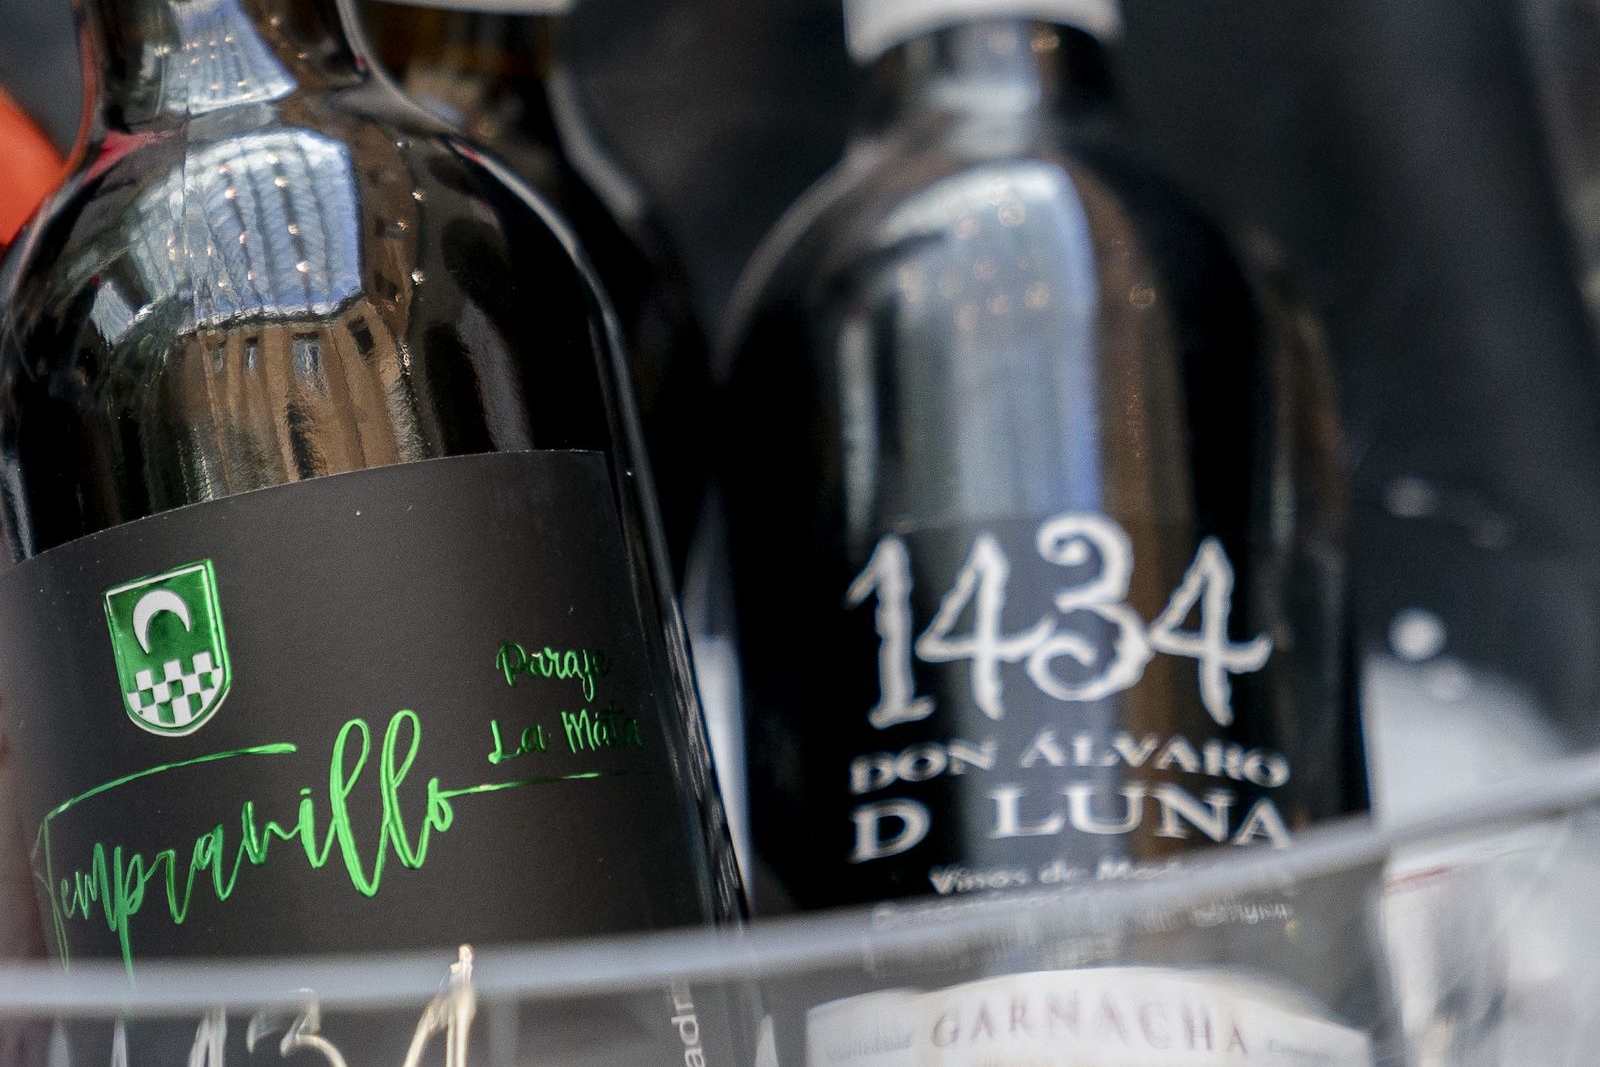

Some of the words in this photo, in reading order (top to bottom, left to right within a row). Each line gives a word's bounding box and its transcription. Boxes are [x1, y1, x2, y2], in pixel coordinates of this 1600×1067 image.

[845, 511, 1276, 730] 1434
[487, 719, 548, 765] La
[849, 737, 998, 795] DON
[848, 797, 933, 864] D
[990, 781, 1294, 851] LUNA
[929, 989, 1251, 1056] GARNACHA
